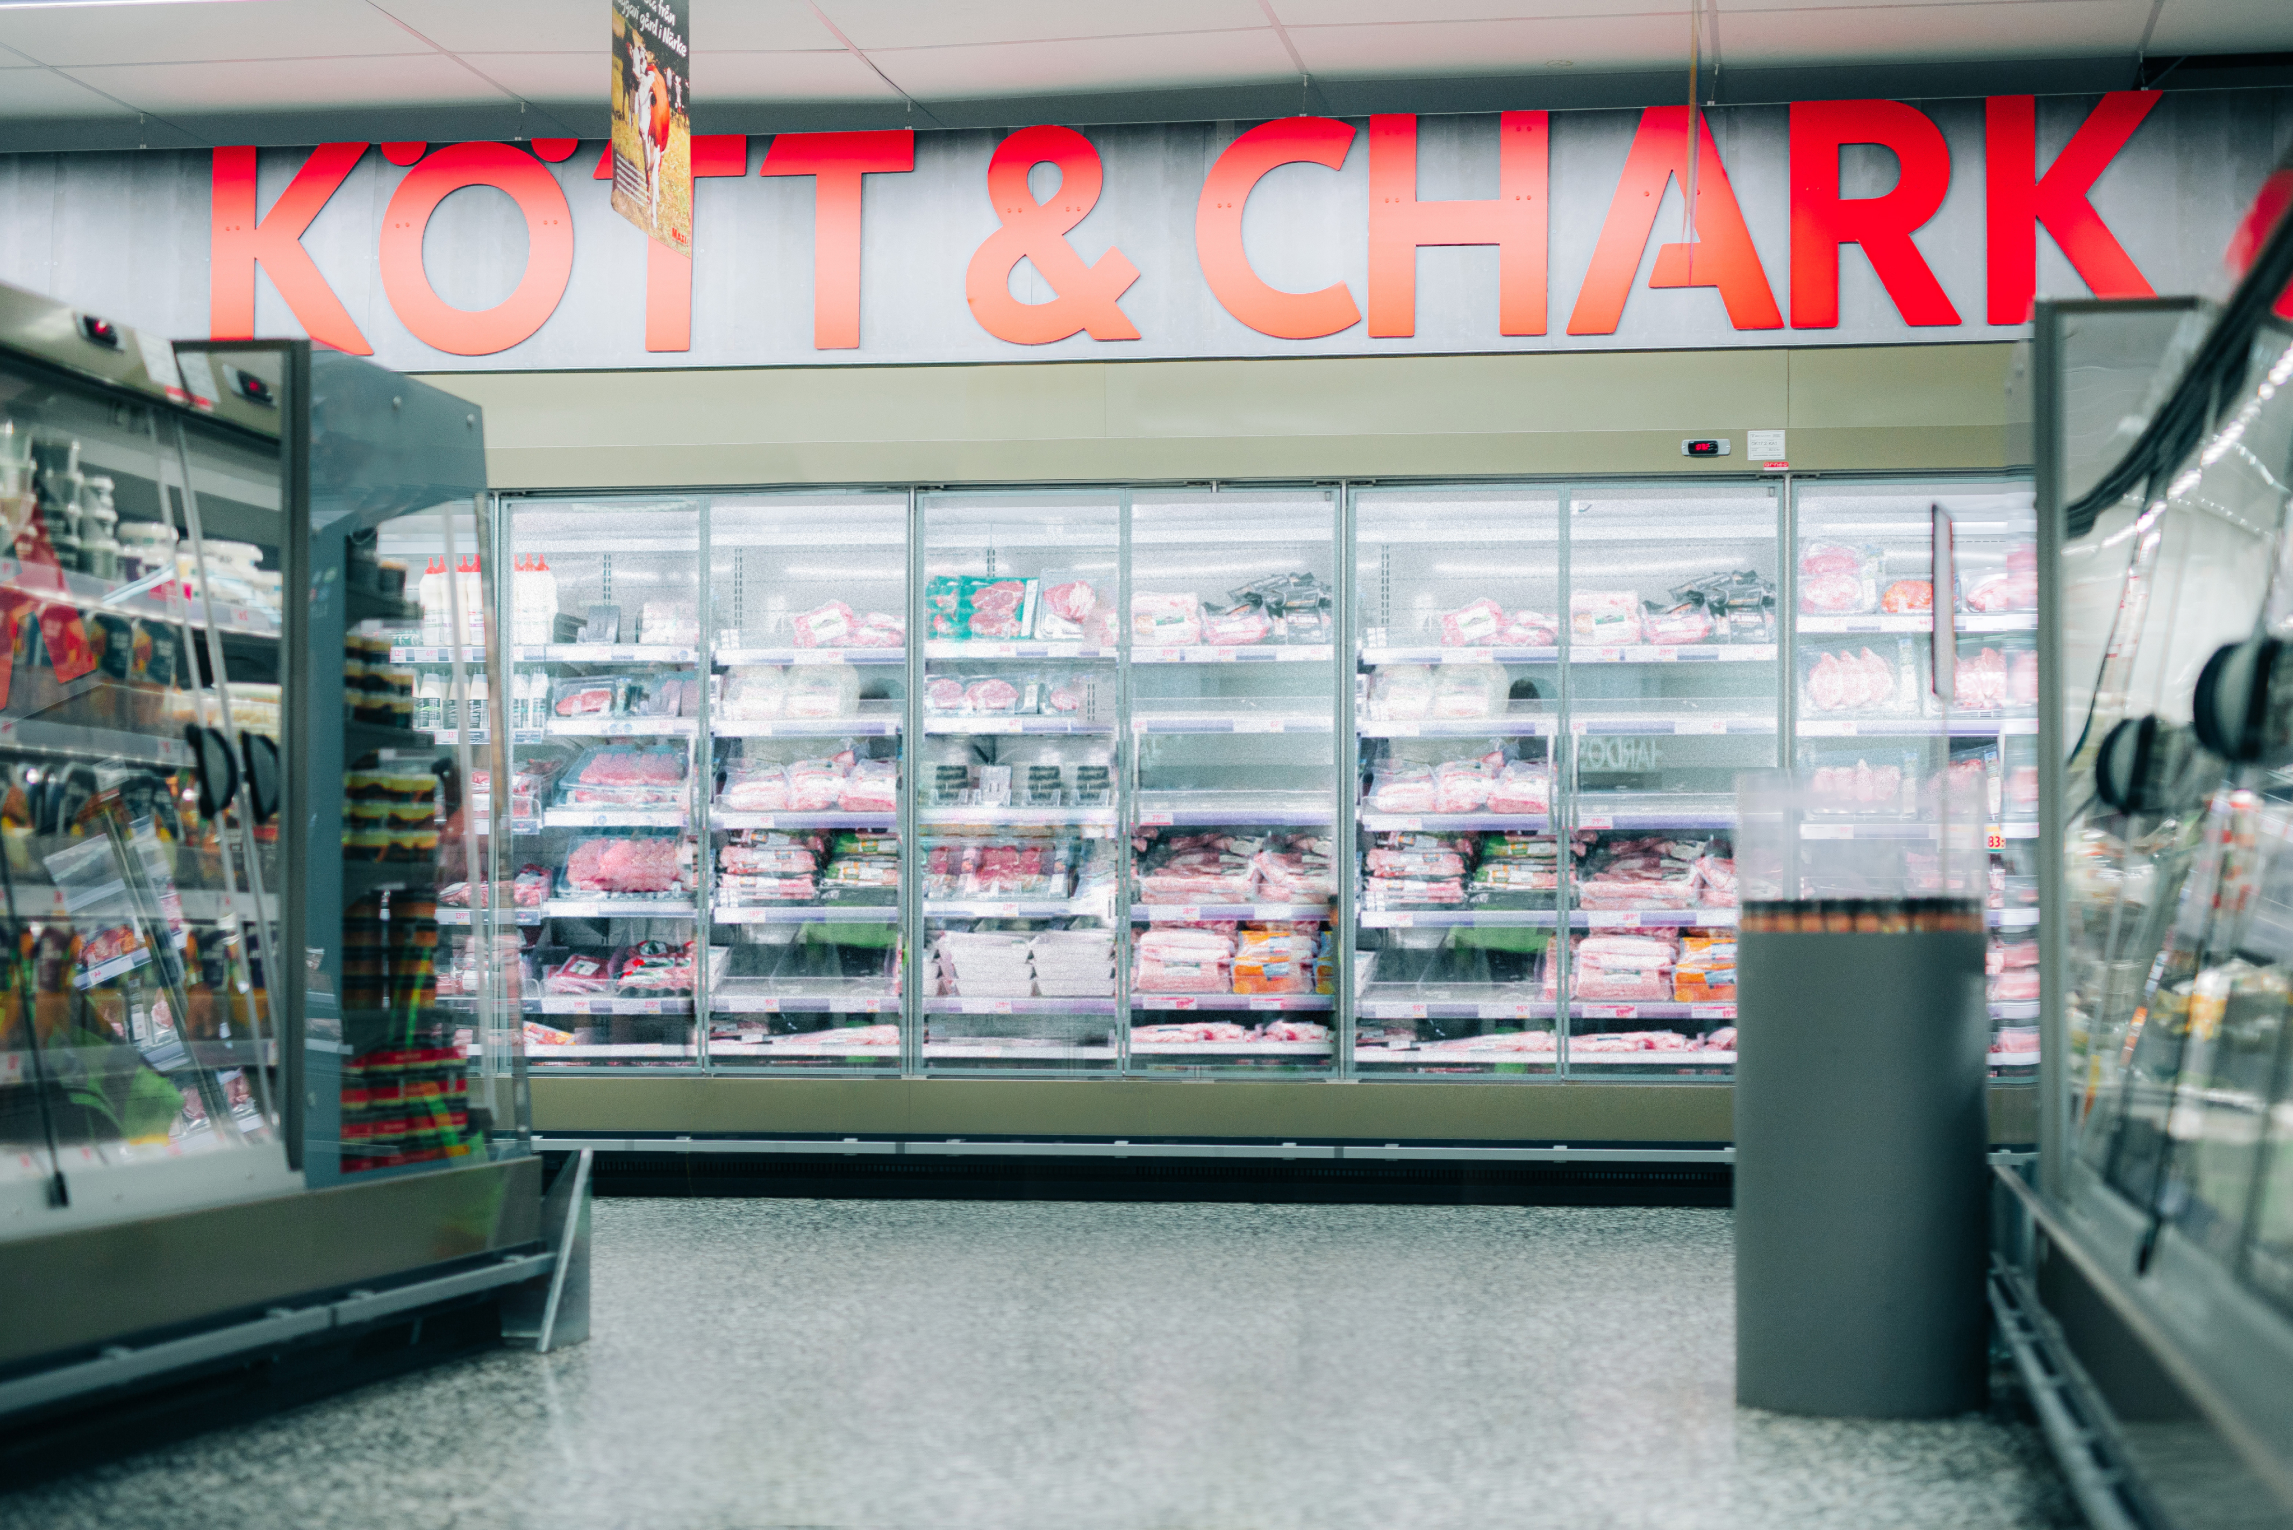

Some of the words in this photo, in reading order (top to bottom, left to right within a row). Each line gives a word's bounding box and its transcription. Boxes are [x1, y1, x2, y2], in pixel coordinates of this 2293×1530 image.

[640, 12, 659, 36] gård
[658, 24, 663, 39] i
[662, 27, 687, 58] Närke
[658, 0, 676, 26] från
[210, 128, 915, 356] KÖTT
[966, 125, 1142, 347] &
[1196, 89, 2164, 339] CHARK
